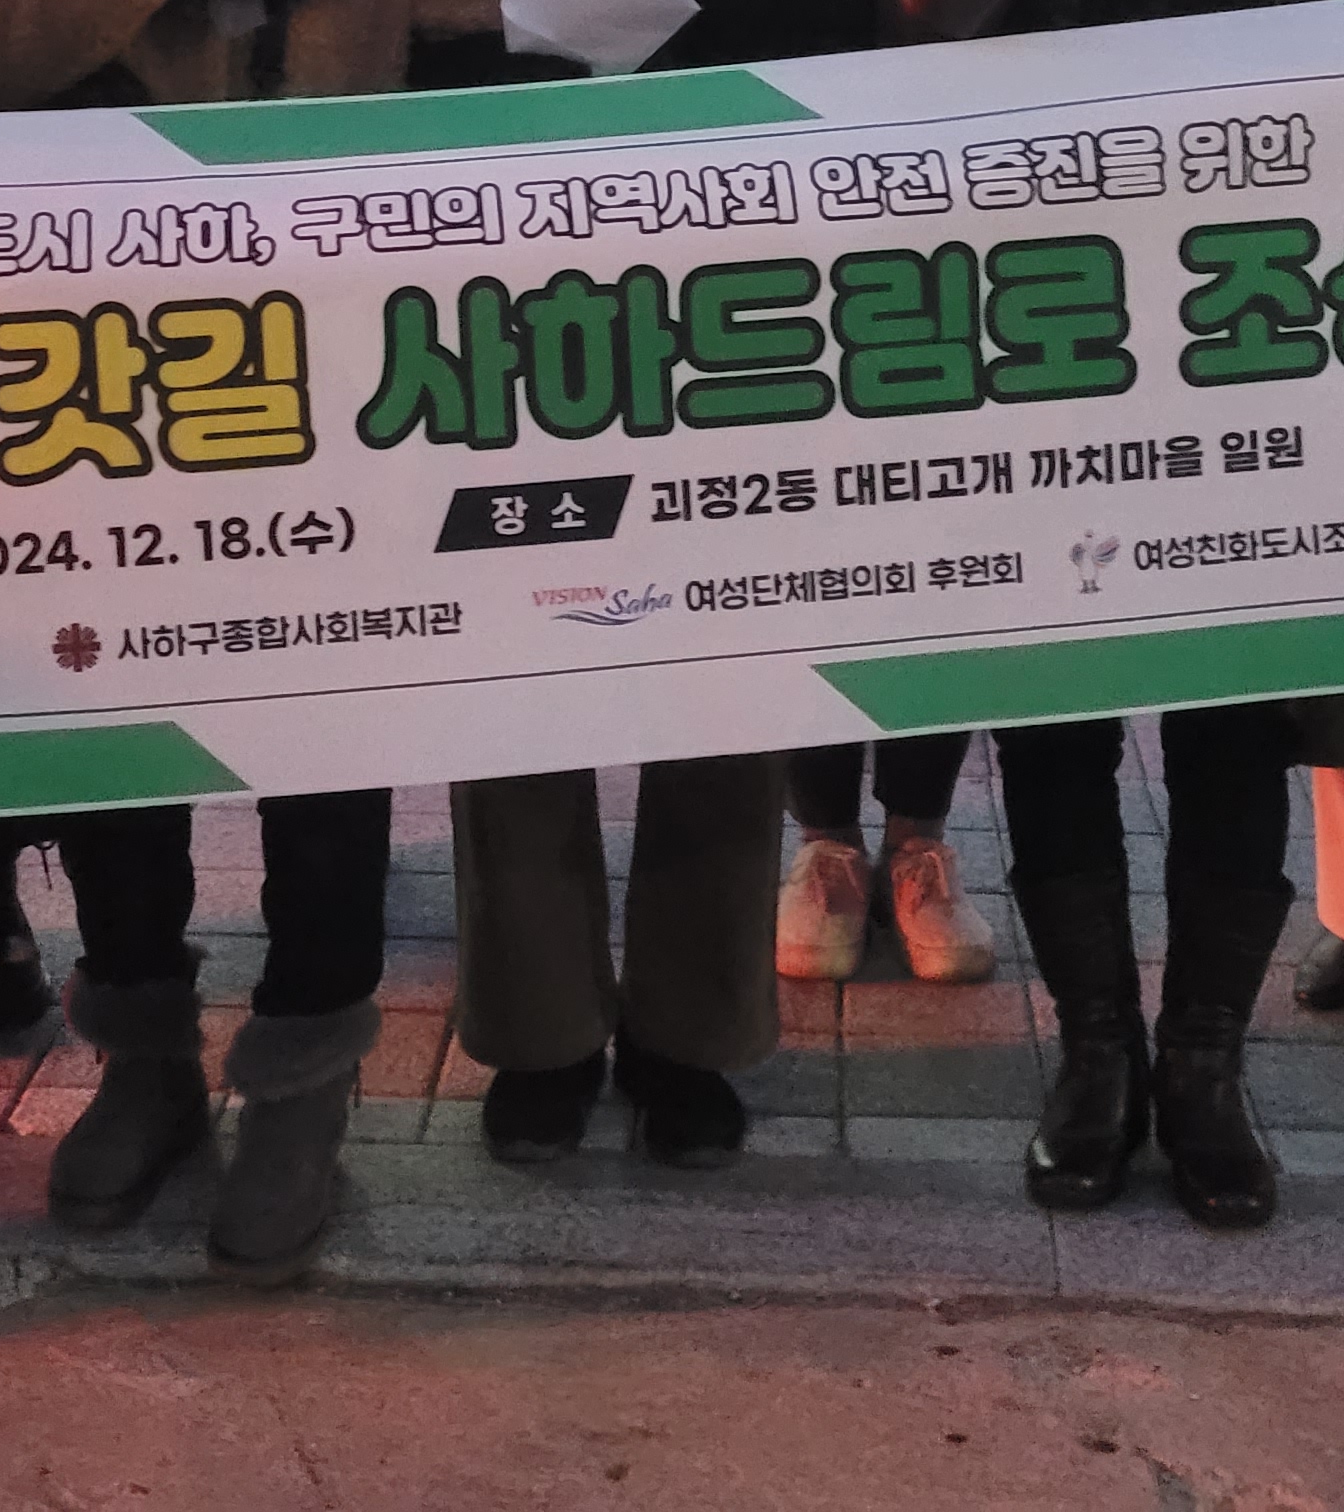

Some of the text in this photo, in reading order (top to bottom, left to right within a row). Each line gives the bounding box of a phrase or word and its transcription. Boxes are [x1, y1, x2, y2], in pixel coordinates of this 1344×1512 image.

[106, 202, 276, 267] 사하,
[291, 183, 505, 257] 구민의
[516, 161, 798, 239] 지역사회
[810, 150, 953, 221] 안전
[962, 126, 1166, 210] 증진을
[1179, 113, 1315, 193] 위한
[356, 234, 1137, 450] 사하드림로
[652, 469, 817, 522] 괴정2동
[835, 452, 1013, 506] 대티고개
[1030, 436, 1203, 488] 까치마을
[1221, 426, 1304, 473] 일원
[108, 524, 179, 567] 12.
[532, 587, 607, 606] VISION
[686, 552, 1023, 611] 여성단체협의회 후원회
[118, 602, 462, 659] 사하구종합사회복지관
